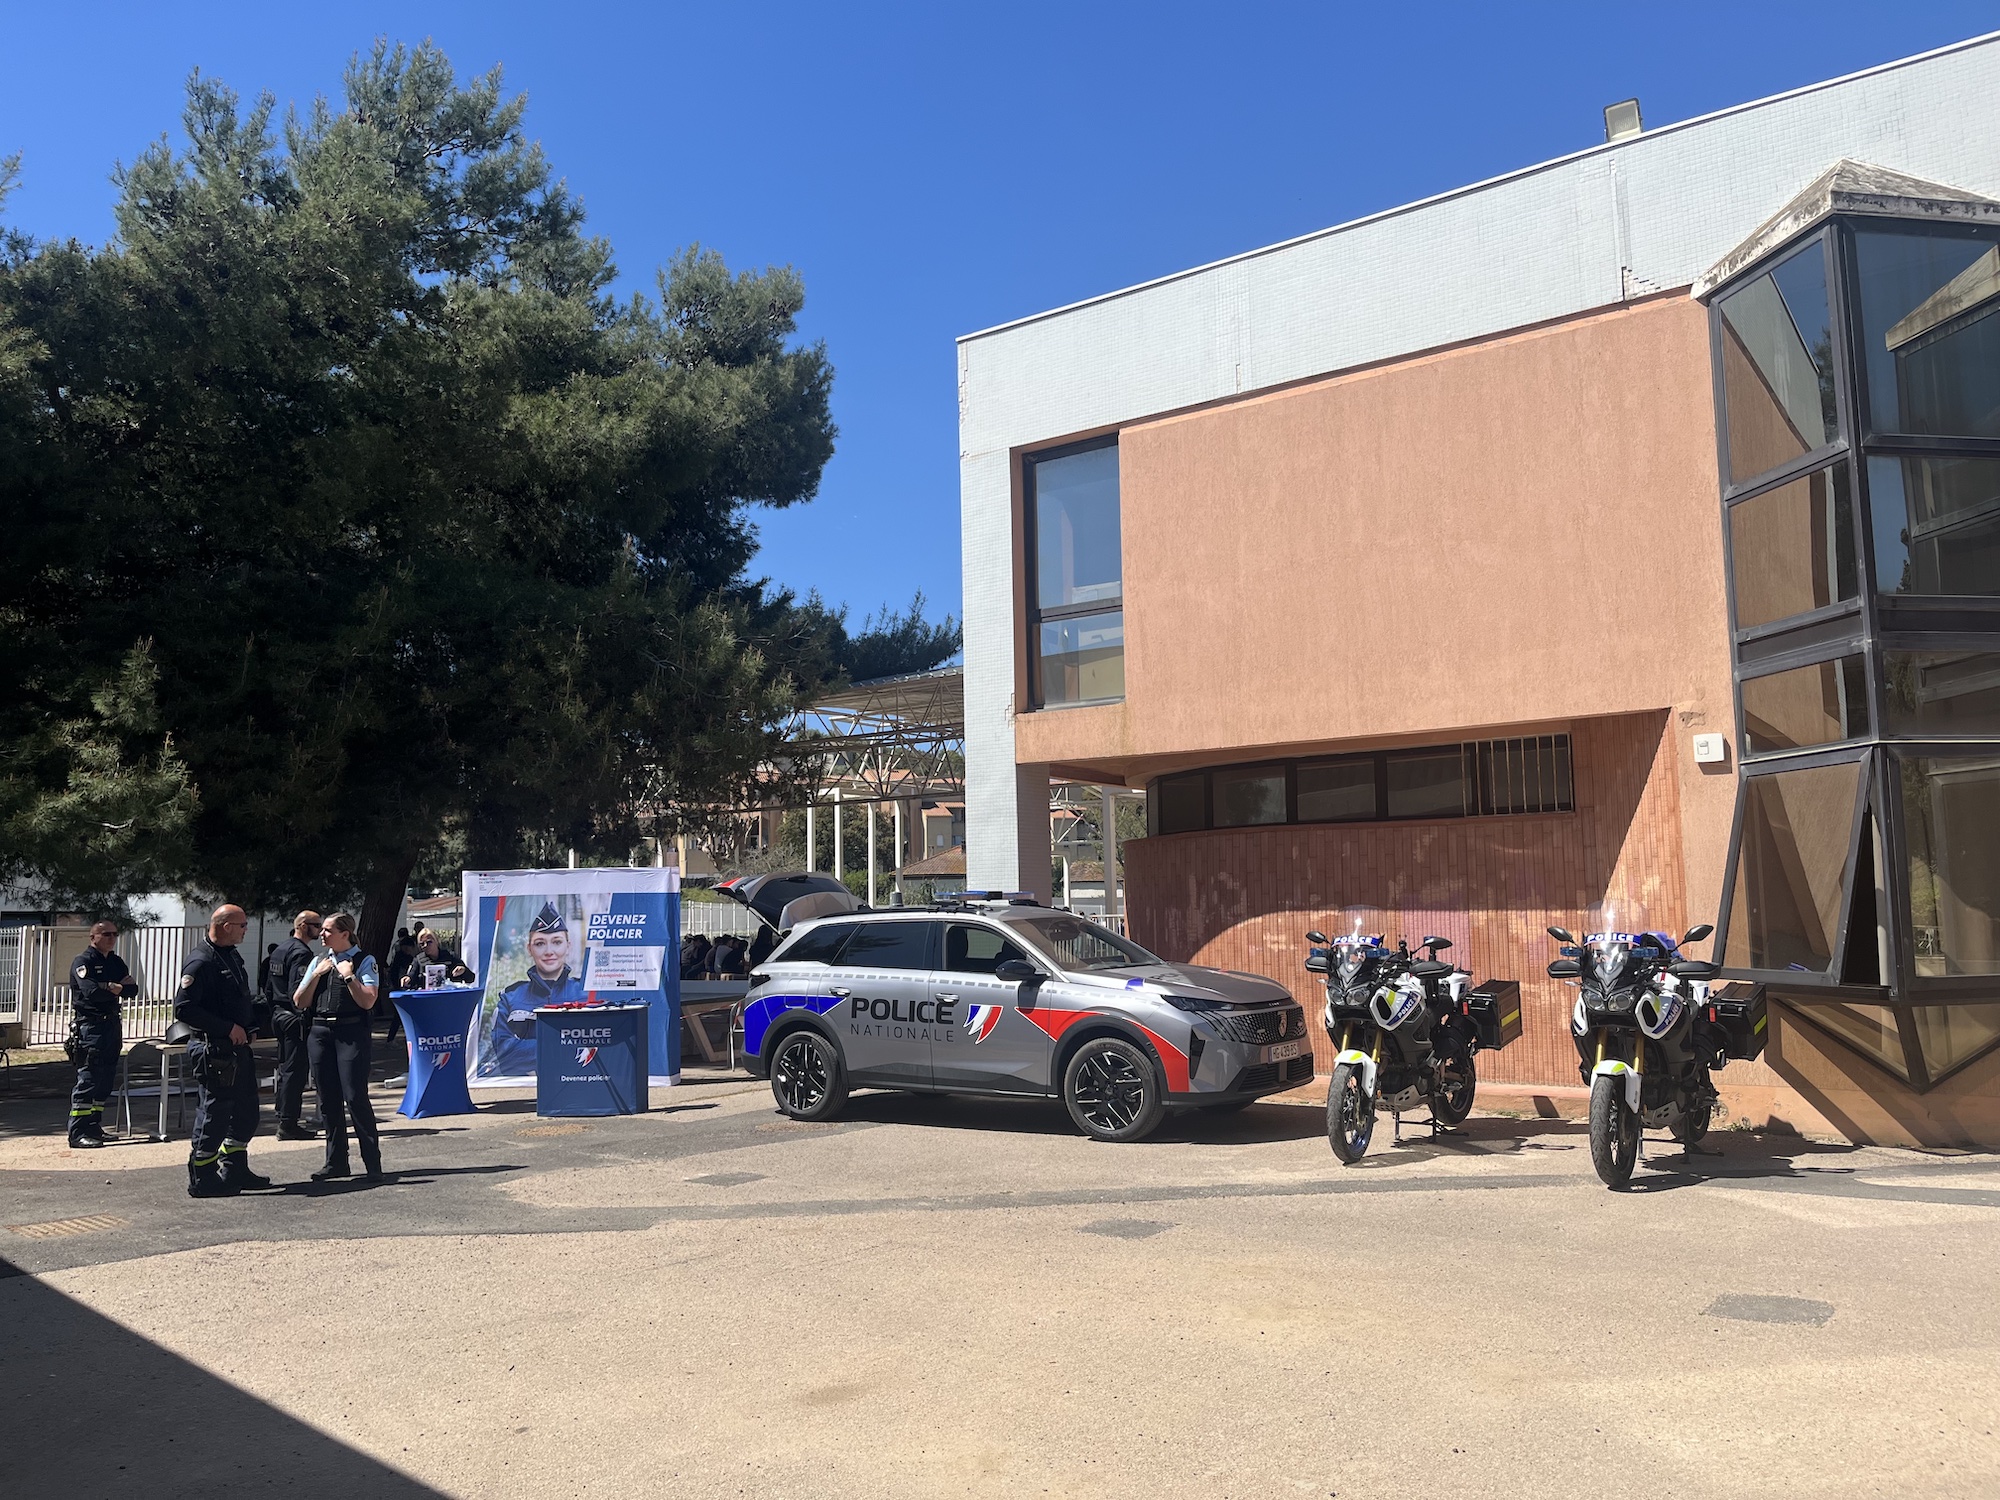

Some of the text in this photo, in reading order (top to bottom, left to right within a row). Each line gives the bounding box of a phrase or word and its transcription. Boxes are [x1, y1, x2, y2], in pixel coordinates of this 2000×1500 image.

[591, 914, 647, 925] DEVENEZ
[589, 928, 643, 939] POLICIER
[1587, 934, 1634, 942] POLICE
[1333, 936, 1373, 944] POLICE
[851, 998, 955, 1025] POLICE
[1397, 998, 1415, 1018] POLICE
[1664, 1004, 1681, 1026] POLICE
[561, 1028, 611, 1038] POLICE
[850, 1024, 954, 1042] NATIONALE
[418, 1034, 461, 1045] POLICE
[418, 1042, 461, 1051] NATIONALE
